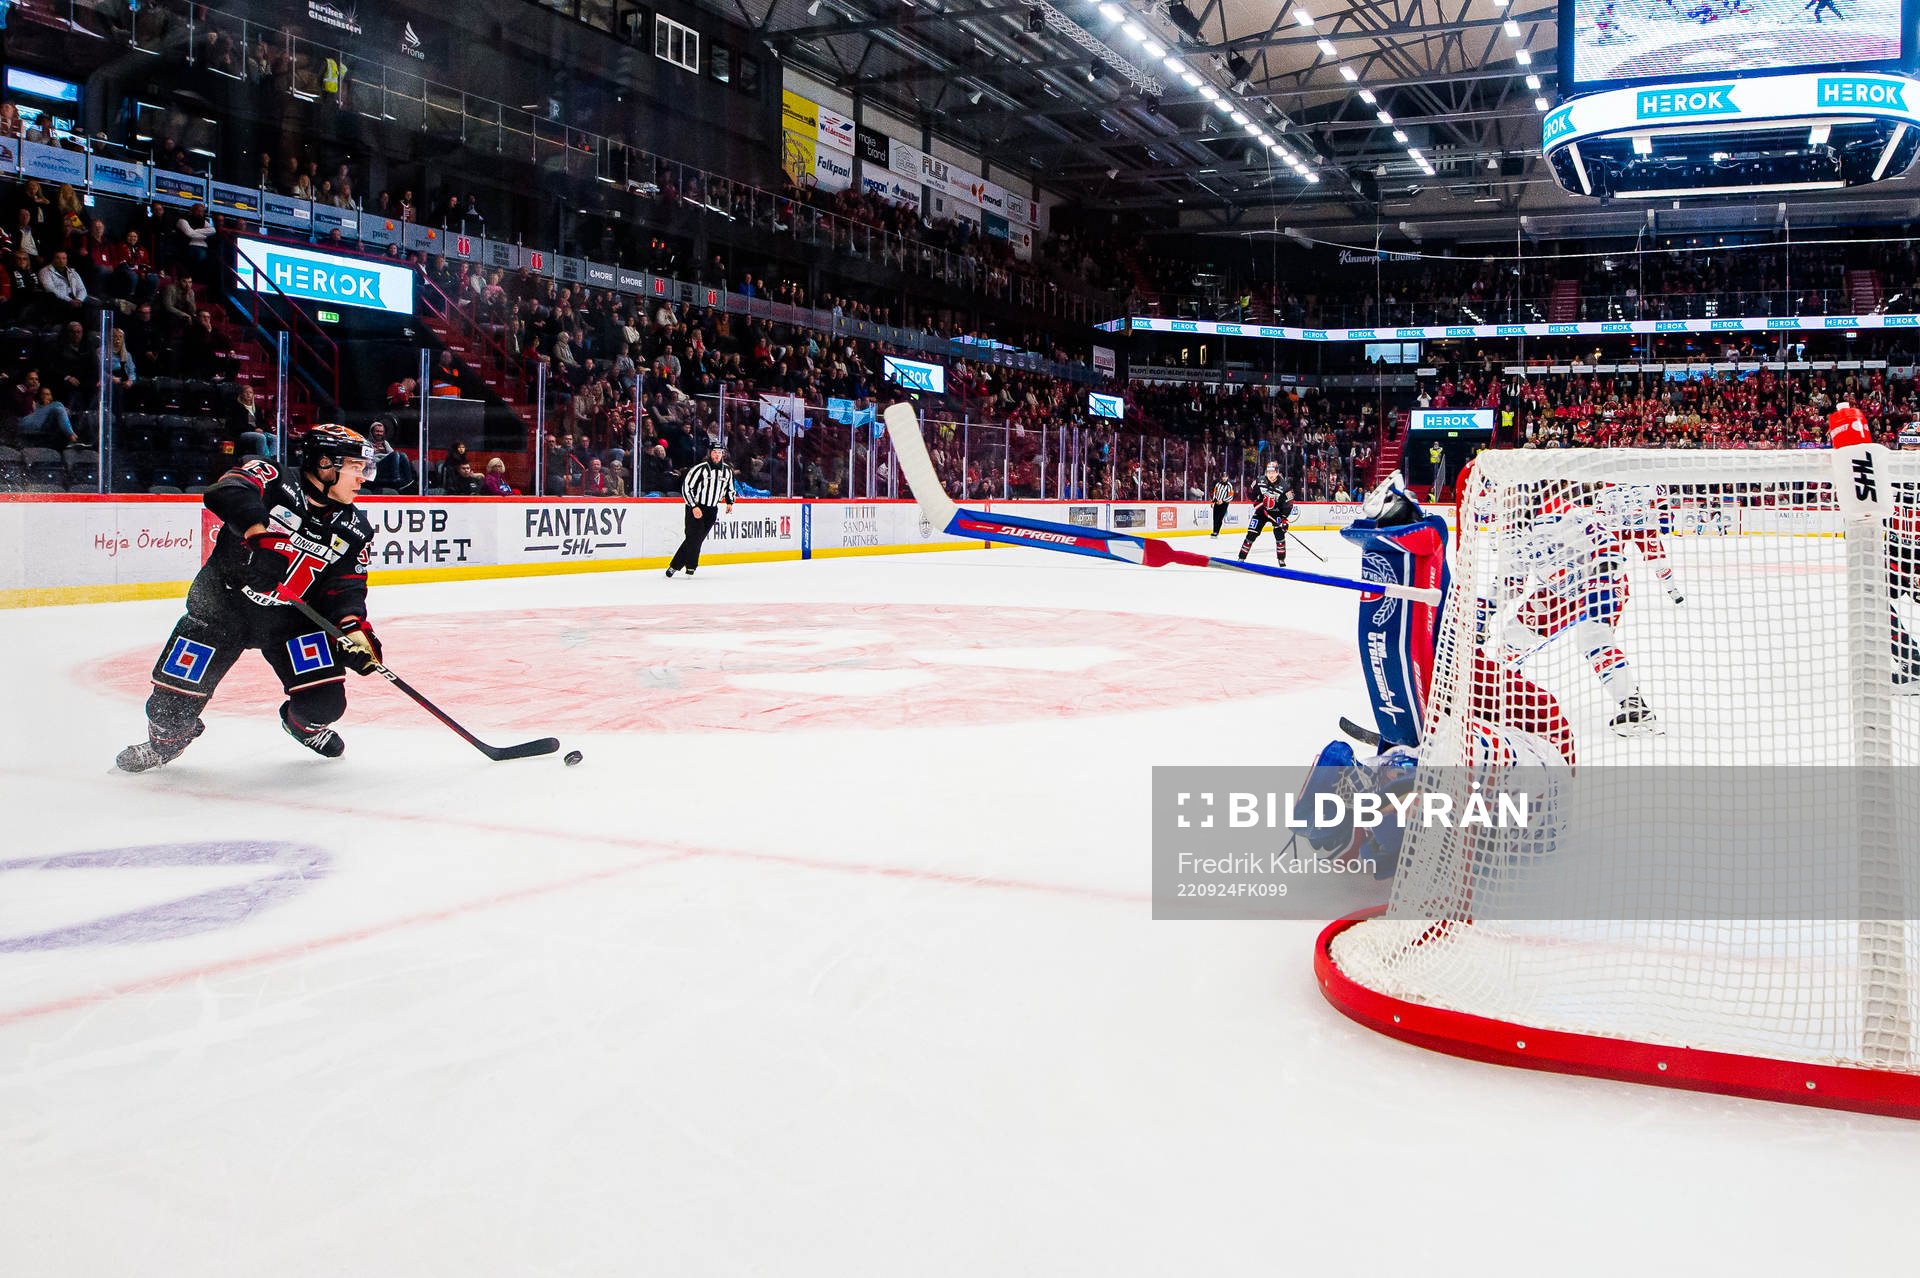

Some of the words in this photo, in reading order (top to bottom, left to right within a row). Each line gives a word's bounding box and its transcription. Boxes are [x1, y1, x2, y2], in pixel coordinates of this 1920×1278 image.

[401, 44, 425, 60] Prone
[1643, 90, 1723, 114] HEROK
[1823, 83, 1898, 105] HEROK
[1543, 114, 1567, 142] EROK
[867, 144, 886, 161] brand
[372, 230, 389, 240] pwc
[274, 261, 376, 300] HEROK
[1132, 320, 1149, 328] EROK
[1447, 328, 1471, 336] HEROK
[1712, 321, 1738, 329] HEROK
[1397, 329, 1421, 337] HEROK
[1426, 415, 1471, 426] HEROK
[1851, 451, 1878, 503] SHL
[1329, 505, 1362, 515] ADDAC
[525, 508, 627, 538] FANTASY
[729, 520, 739, 540] VI
[741, 520, 762, 539] SOM
[765, 517, 777, 539] ÄR
[843, 520, 878, 533] SANDAHL
[94, 531, 129, 557] Heja
[137, 528, 193, 549] Örebro!
[843, 534, 879, 547] PARTNERS
[997, 526, 1078, 545] SUPREME
[561, 538, 595, 556] SHL
